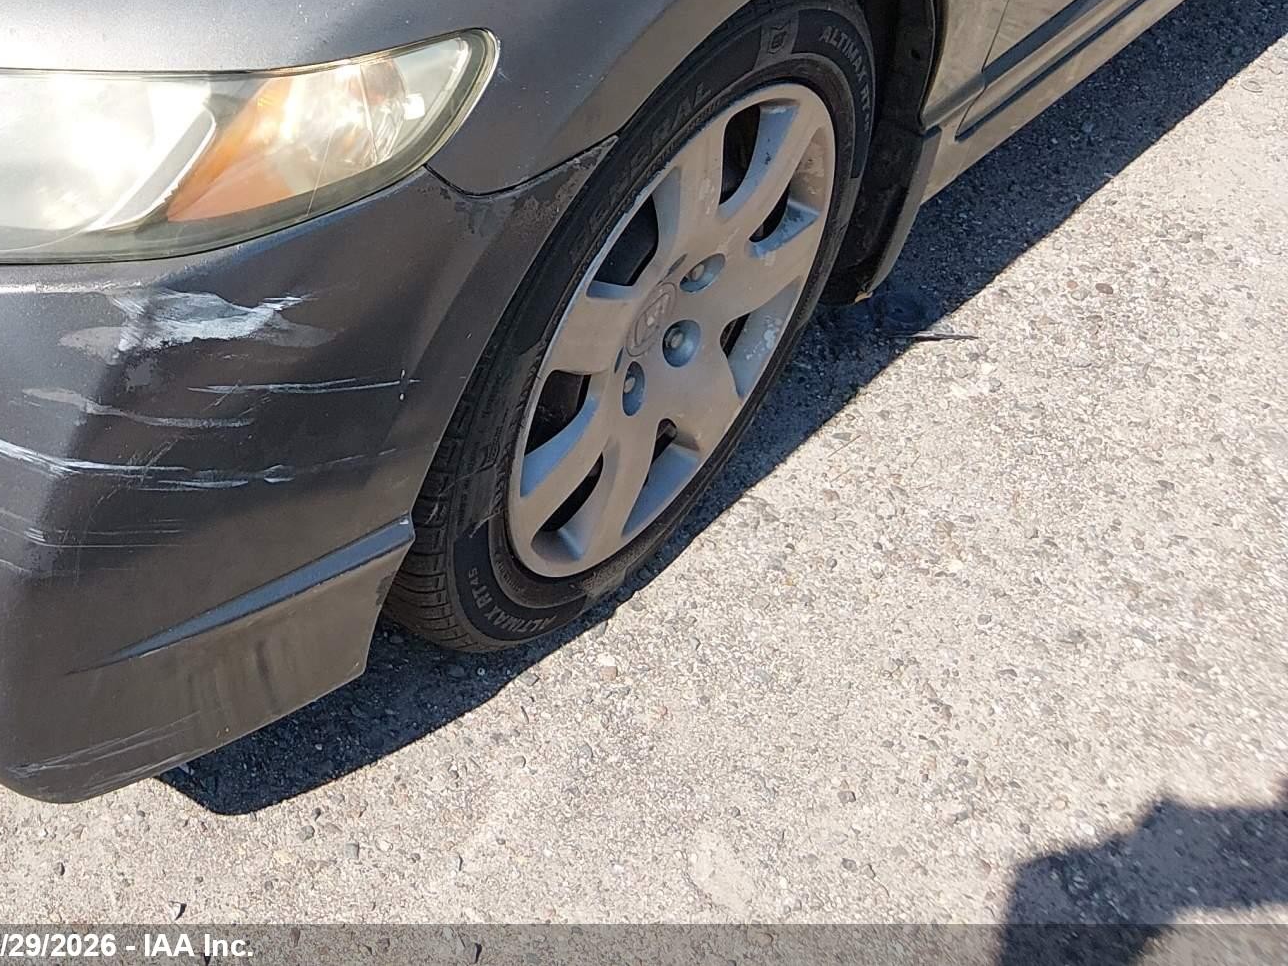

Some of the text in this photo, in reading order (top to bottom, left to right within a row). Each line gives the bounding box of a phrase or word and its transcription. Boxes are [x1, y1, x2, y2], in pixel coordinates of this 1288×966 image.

[818, 25, 867, 82] ALTIMAX
[471, 585, 493, 609] RT
[484, 605, 558, 634] ALTIMAX
